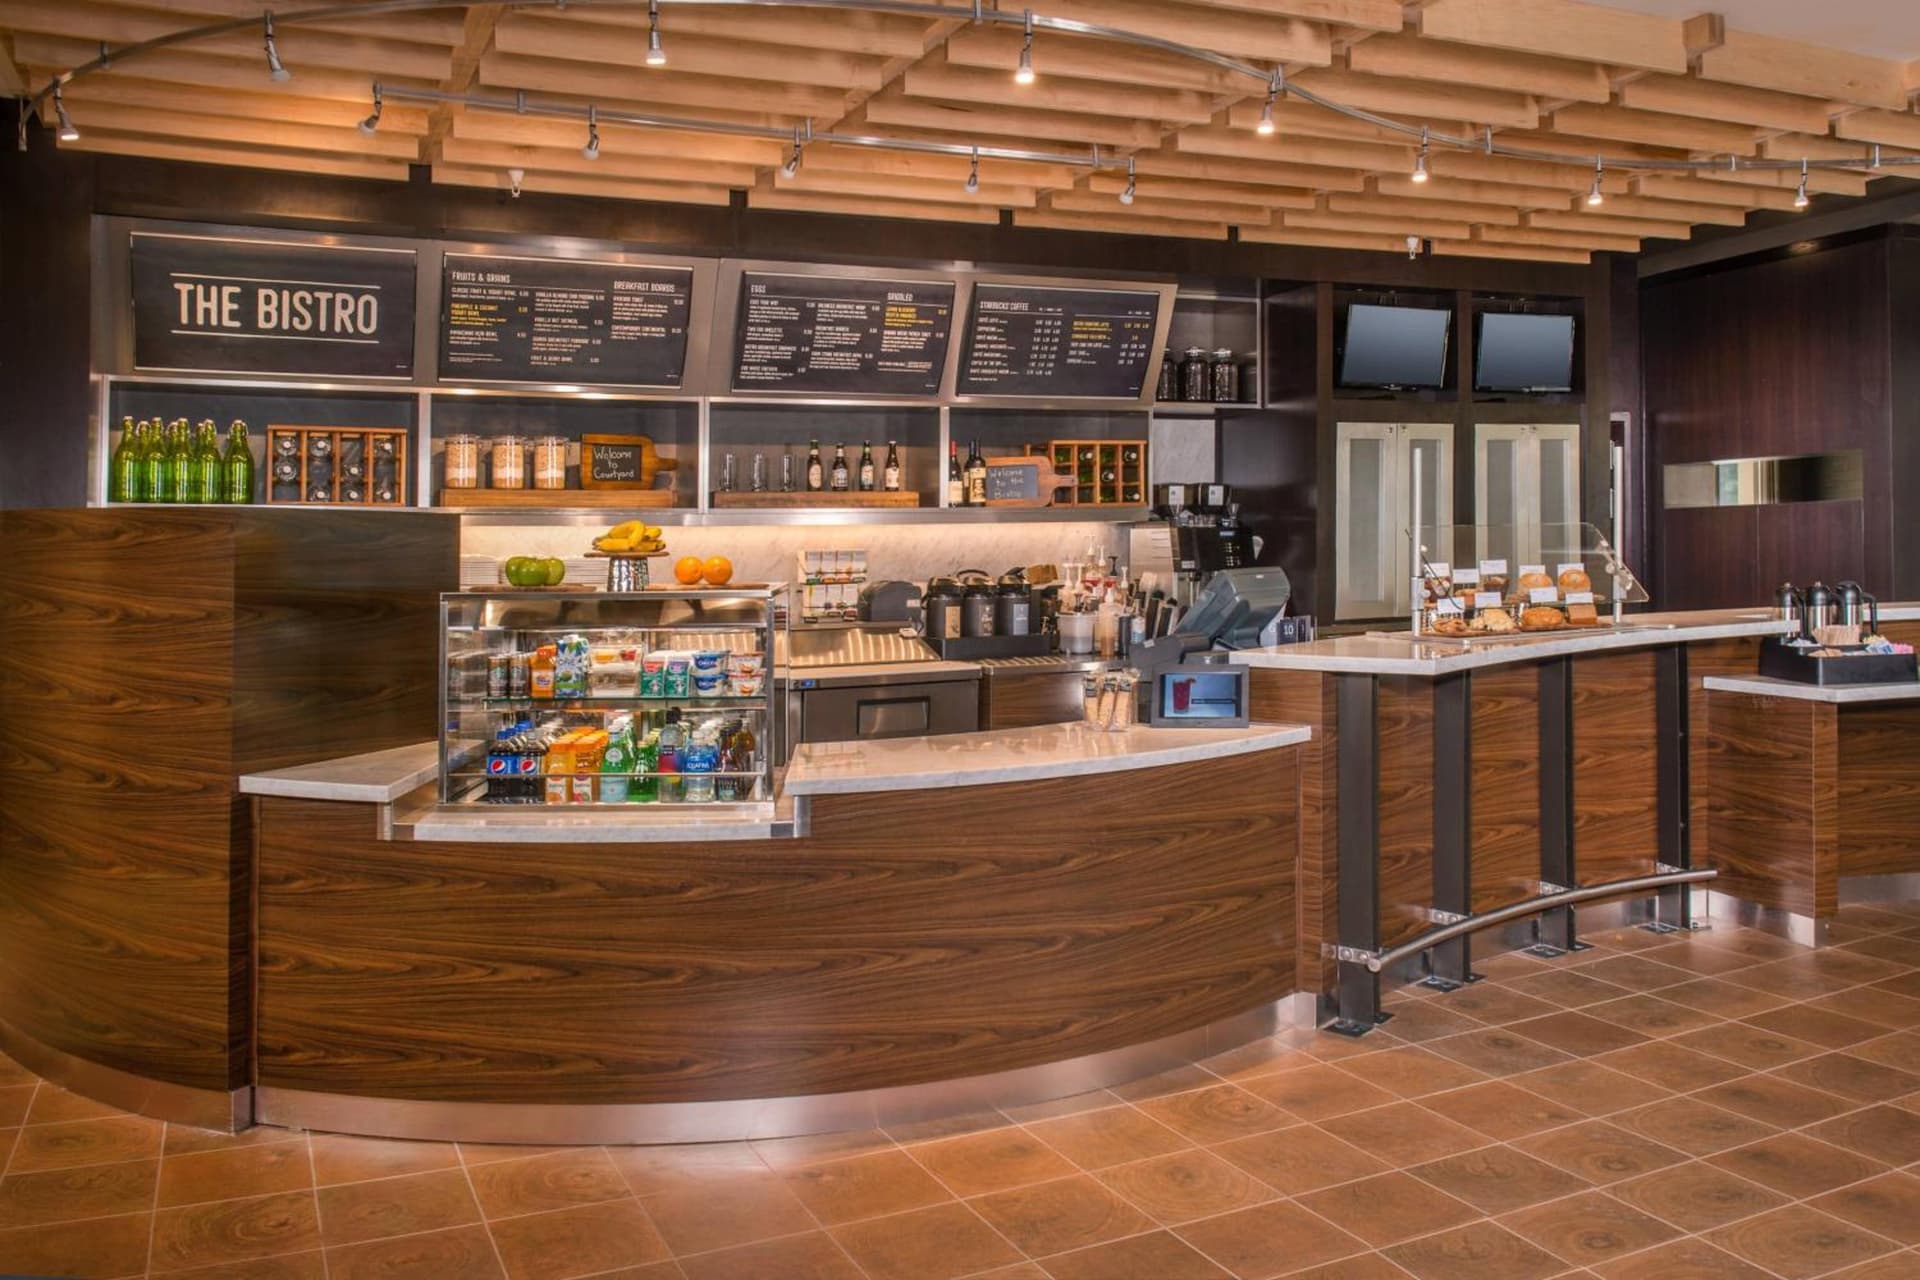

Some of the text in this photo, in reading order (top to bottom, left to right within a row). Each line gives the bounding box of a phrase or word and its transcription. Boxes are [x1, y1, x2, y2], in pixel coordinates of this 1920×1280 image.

[452, 271, 511, 284] FRUITS & GRAINS
[613, 280, 675, 293] BREAKFAST BOARDS
[751, 285, 766, 293] EGGS
[173, 283, 378, 334] THE BISTRO
[980, 301, 1009, 310] STARBUCKS
[1010, 302, 1029, 311] COFFEE
[593, 446, 632, 460] Welcome
[607, 460, 618, 469] to
[593, 466, 635, 480] Courtyard
[989, 468, 1023, 478] Welcome
